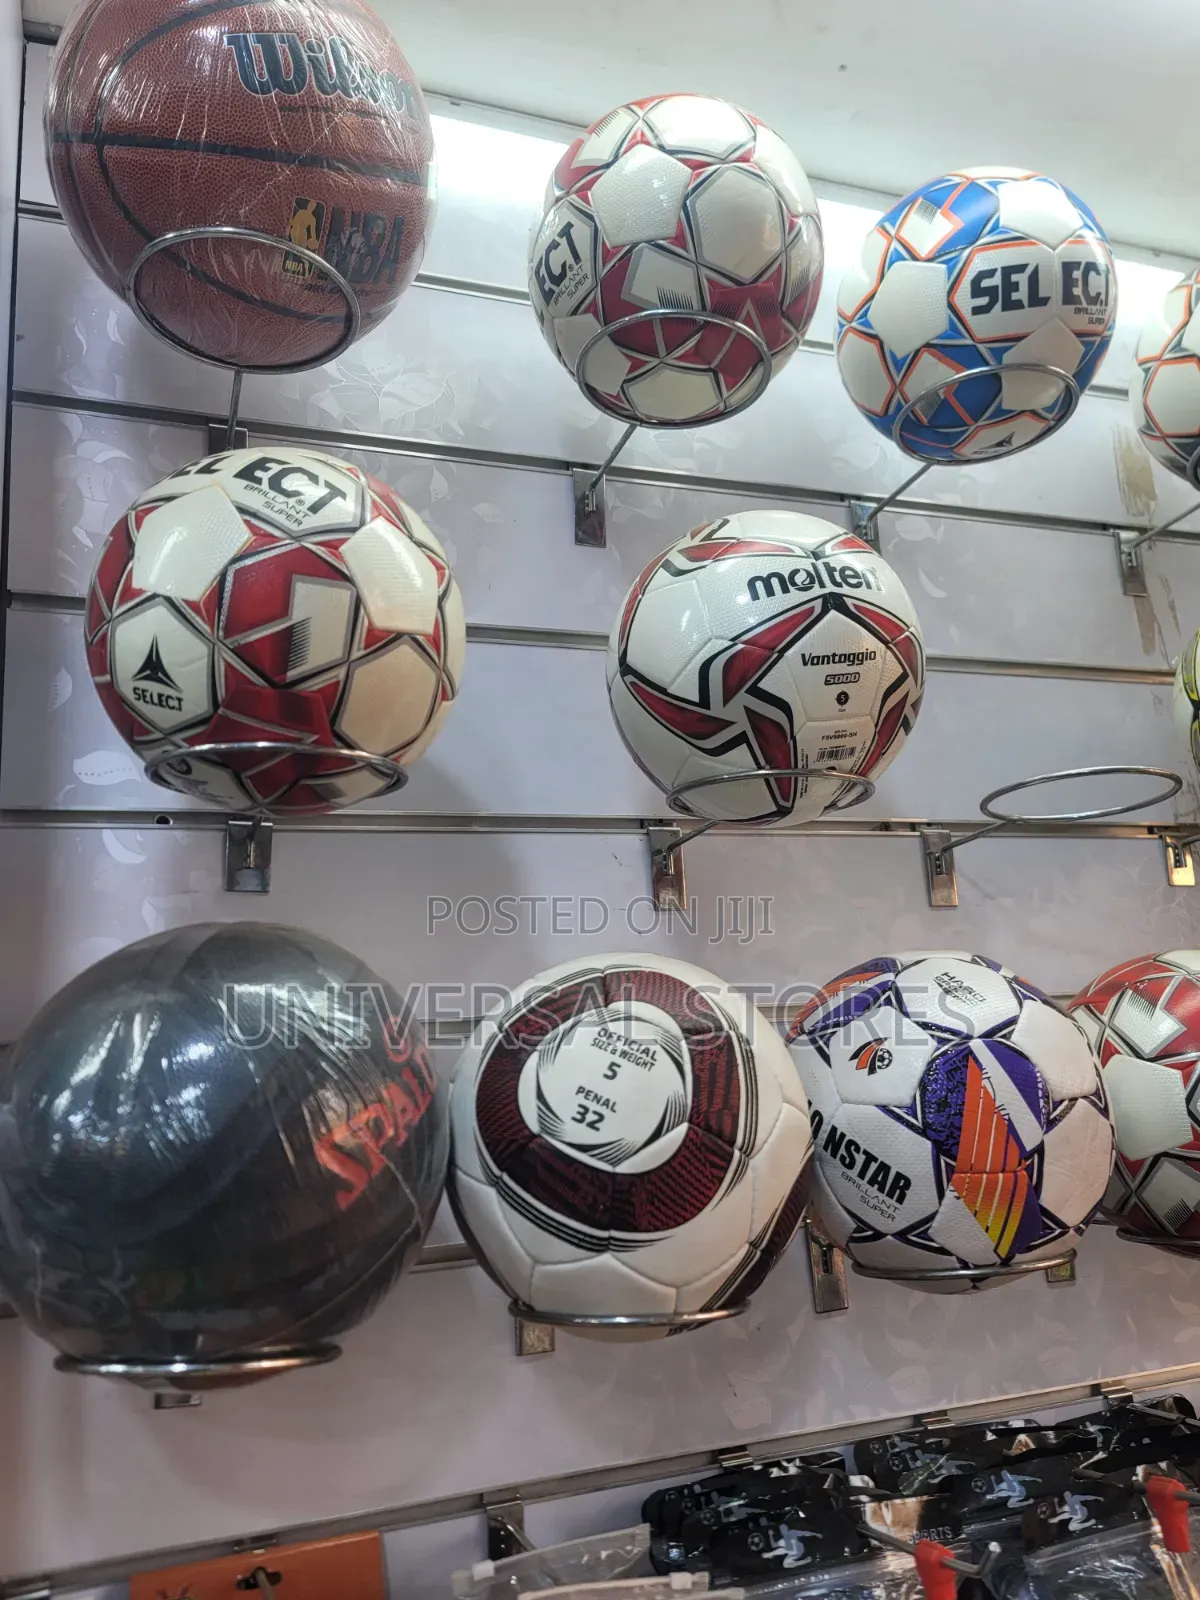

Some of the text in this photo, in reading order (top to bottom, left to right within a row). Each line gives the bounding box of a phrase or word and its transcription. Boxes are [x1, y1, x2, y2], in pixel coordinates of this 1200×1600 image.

[326, 206, 405, 285] NBA
[285, 260, 304, 273] NBA
[552, 264, 584, 306] BRILLANT
[566, 273, 589, 299] SUPER
[243, 484, 312, 519] BRILLANT
[261, 500, 304, 527] SUPER
[746, 561, 884, 602] molten
[801, 648, 877, 667] Vantaggio
[824, 671, 861, 686] 5000
[133, 686, 184, 712] SELECT
[590, 1037, 611, 1052] SIZE
[618, 1048, 656, 1073] WEIGHT
[597, 1027, 658, 1062] OFFICIAL
[602, 1061, 622, 1081] 5
[575, 1085, 617, 1114] PENAL
[571, 1103, 605, 1133] 32
[841, 1171, 901, 1214] BRILLANT
[860, 1195, 897, 1222] SUPER
[907, 1525, 954, 1545] SPORTS
